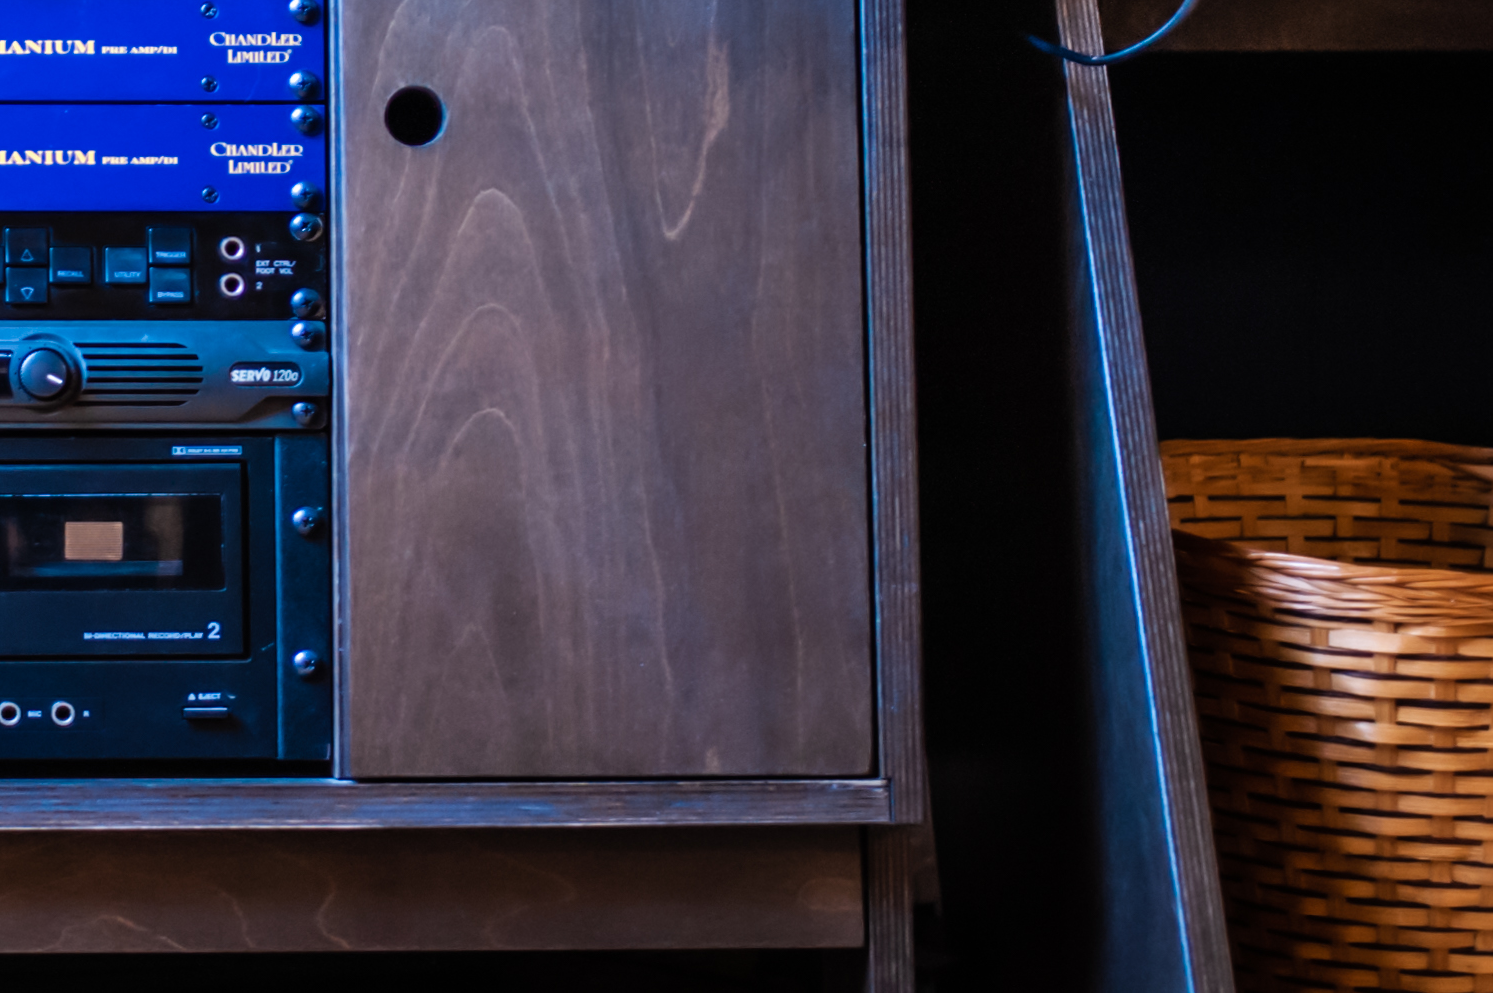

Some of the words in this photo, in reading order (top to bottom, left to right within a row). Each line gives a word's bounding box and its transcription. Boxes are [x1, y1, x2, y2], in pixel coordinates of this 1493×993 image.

[101, 46, 127, 55] PRE
[130, 46, 178, 55] AMP/DI
[101, 157, 128, 166] PRE
[130, 157, 179, 166] AMP/DI
[231, 367, 271, 382] SERVO
[208, 623, 220, 639] 2
